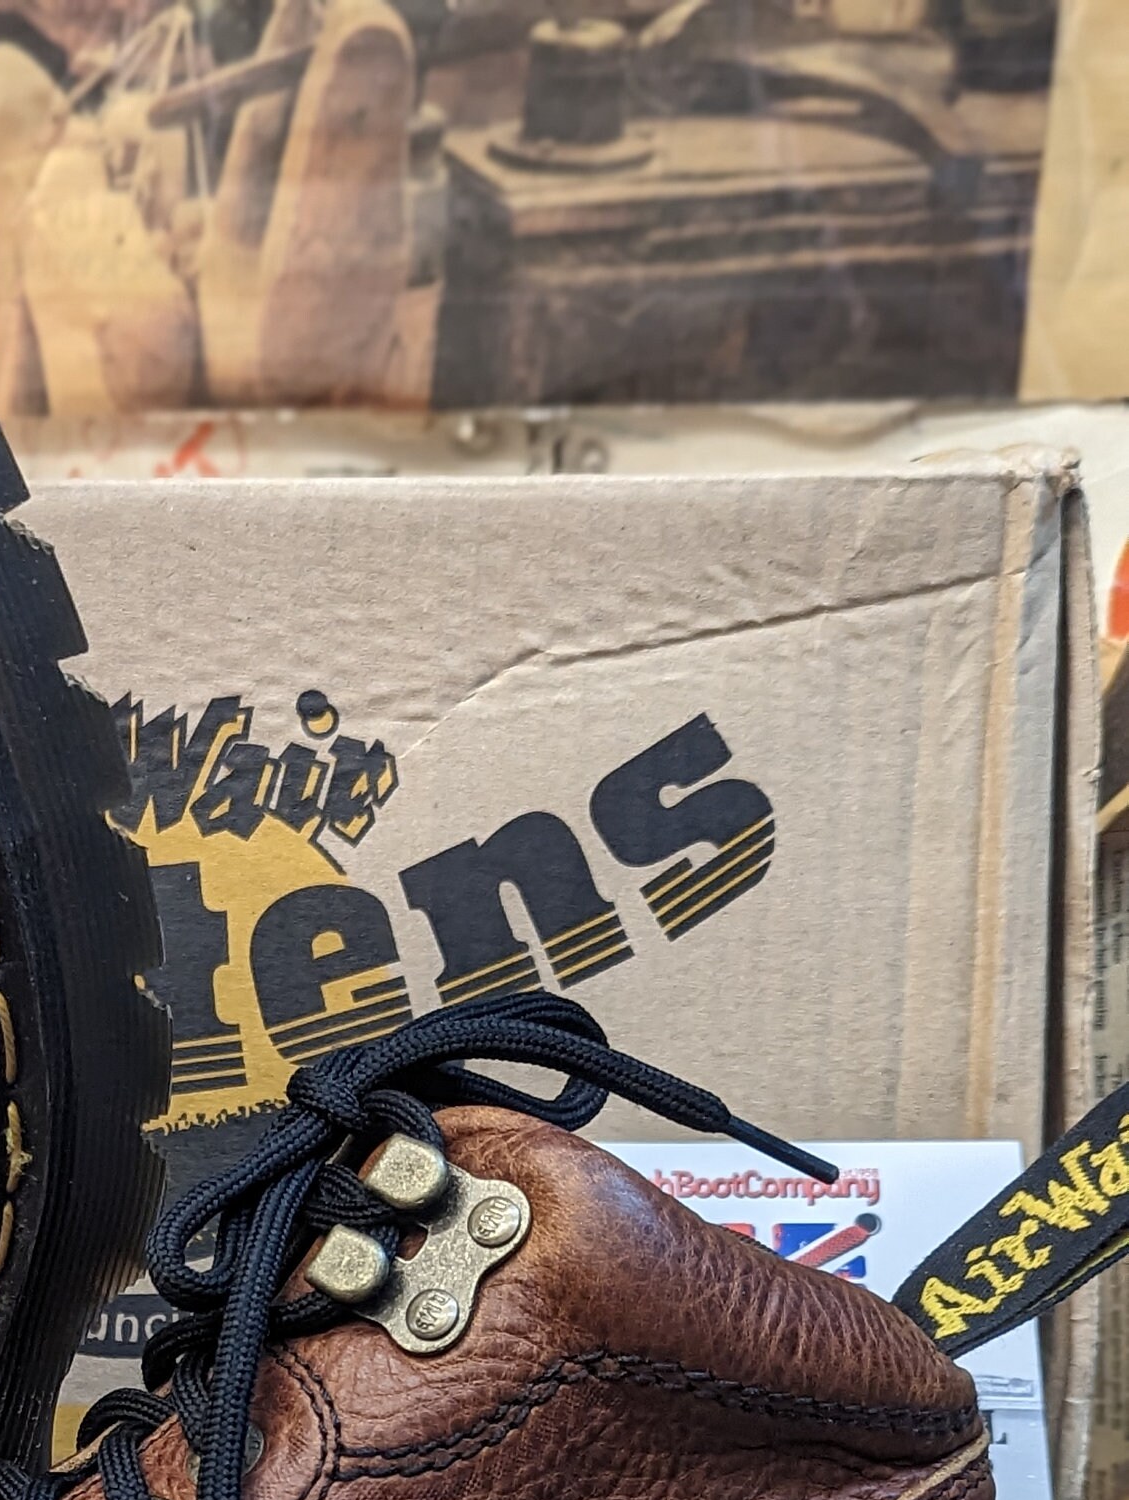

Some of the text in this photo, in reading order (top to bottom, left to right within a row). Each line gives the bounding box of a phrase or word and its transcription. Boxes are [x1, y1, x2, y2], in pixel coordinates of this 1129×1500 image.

[106, 689, 399, 848] Wair
[138, 714, 775, 1095] tens
[654, 1170, 880, 1206] hBootCompany
